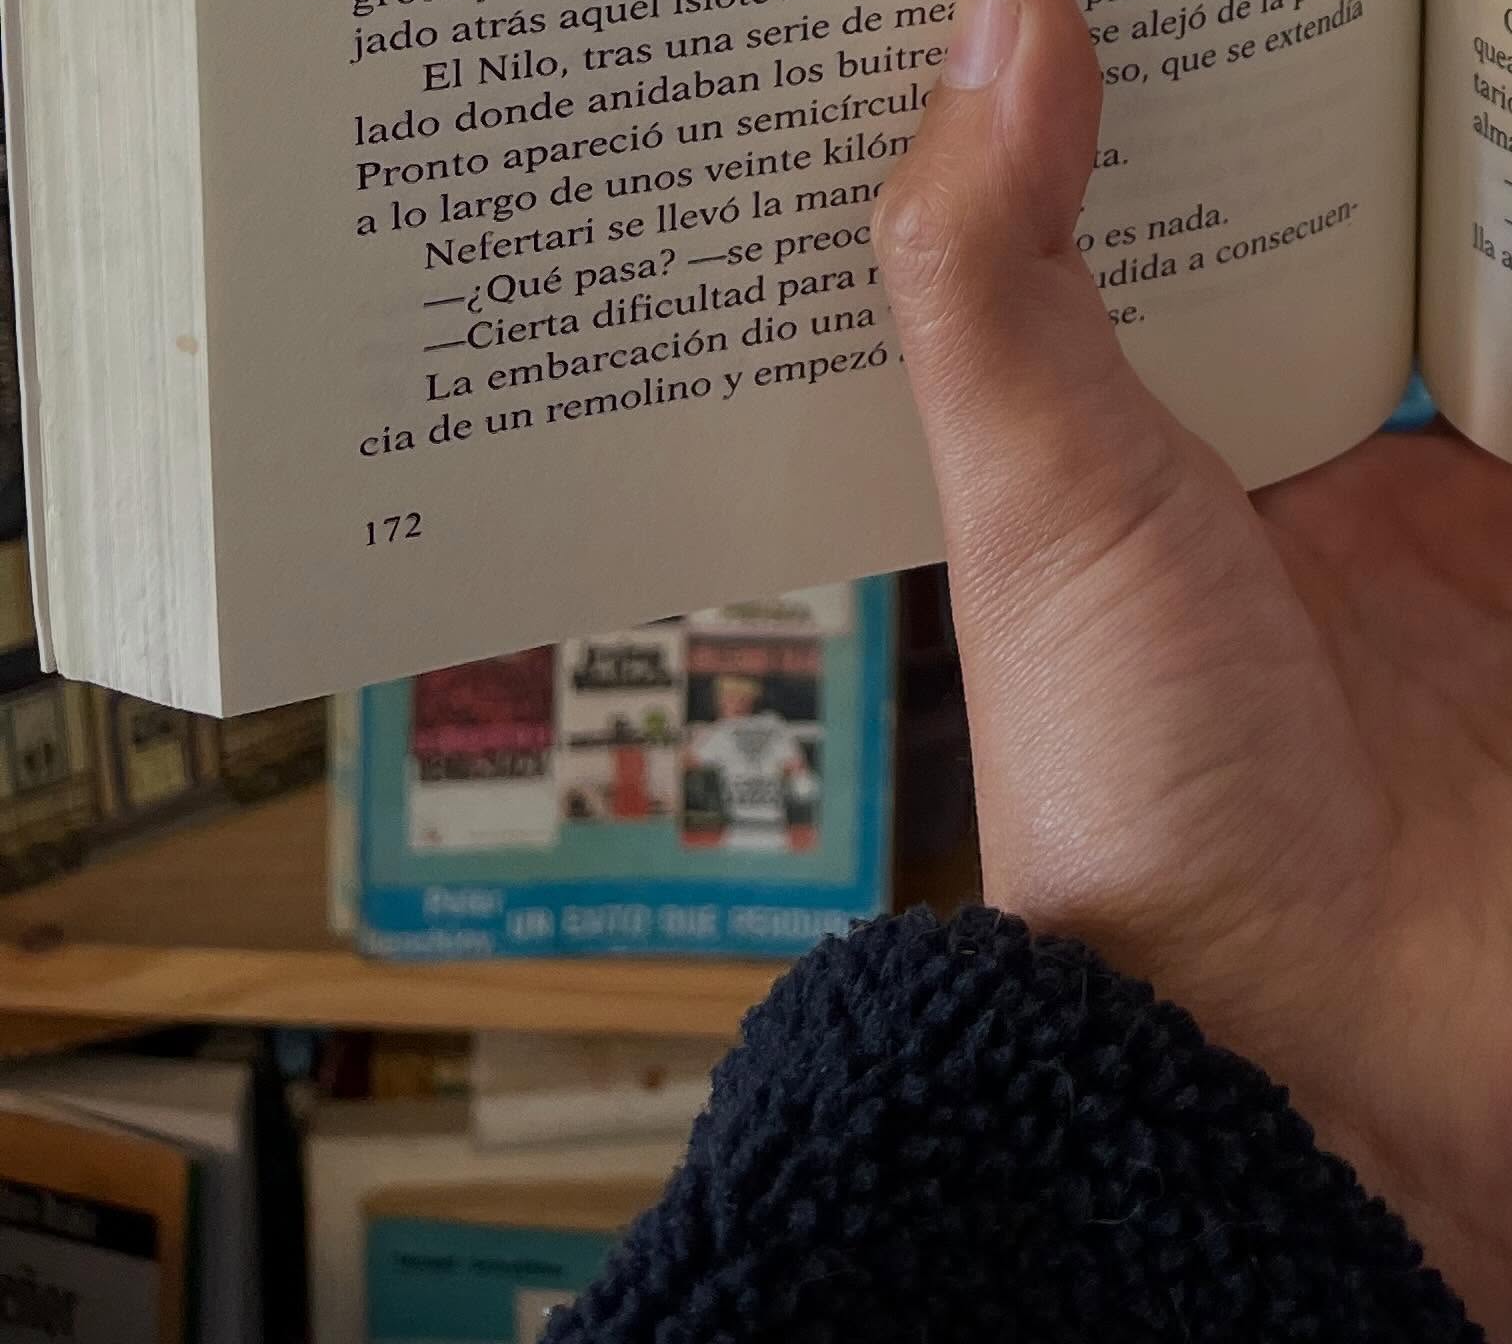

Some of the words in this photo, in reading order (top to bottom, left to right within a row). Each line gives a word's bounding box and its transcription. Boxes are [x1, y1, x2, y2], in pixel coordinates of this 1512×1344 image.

[1471, 221, 1497, 260] lla
[359, 425, 417, 458] cia
[428, 412, 473, 445] de
[481, 407, 535, 435] un
[545, 377, 712, 425] remolino
[721, 370, 744, 401] y
[753, 344, 888, 389] empezó
[365, 511, 423, 547] 172
